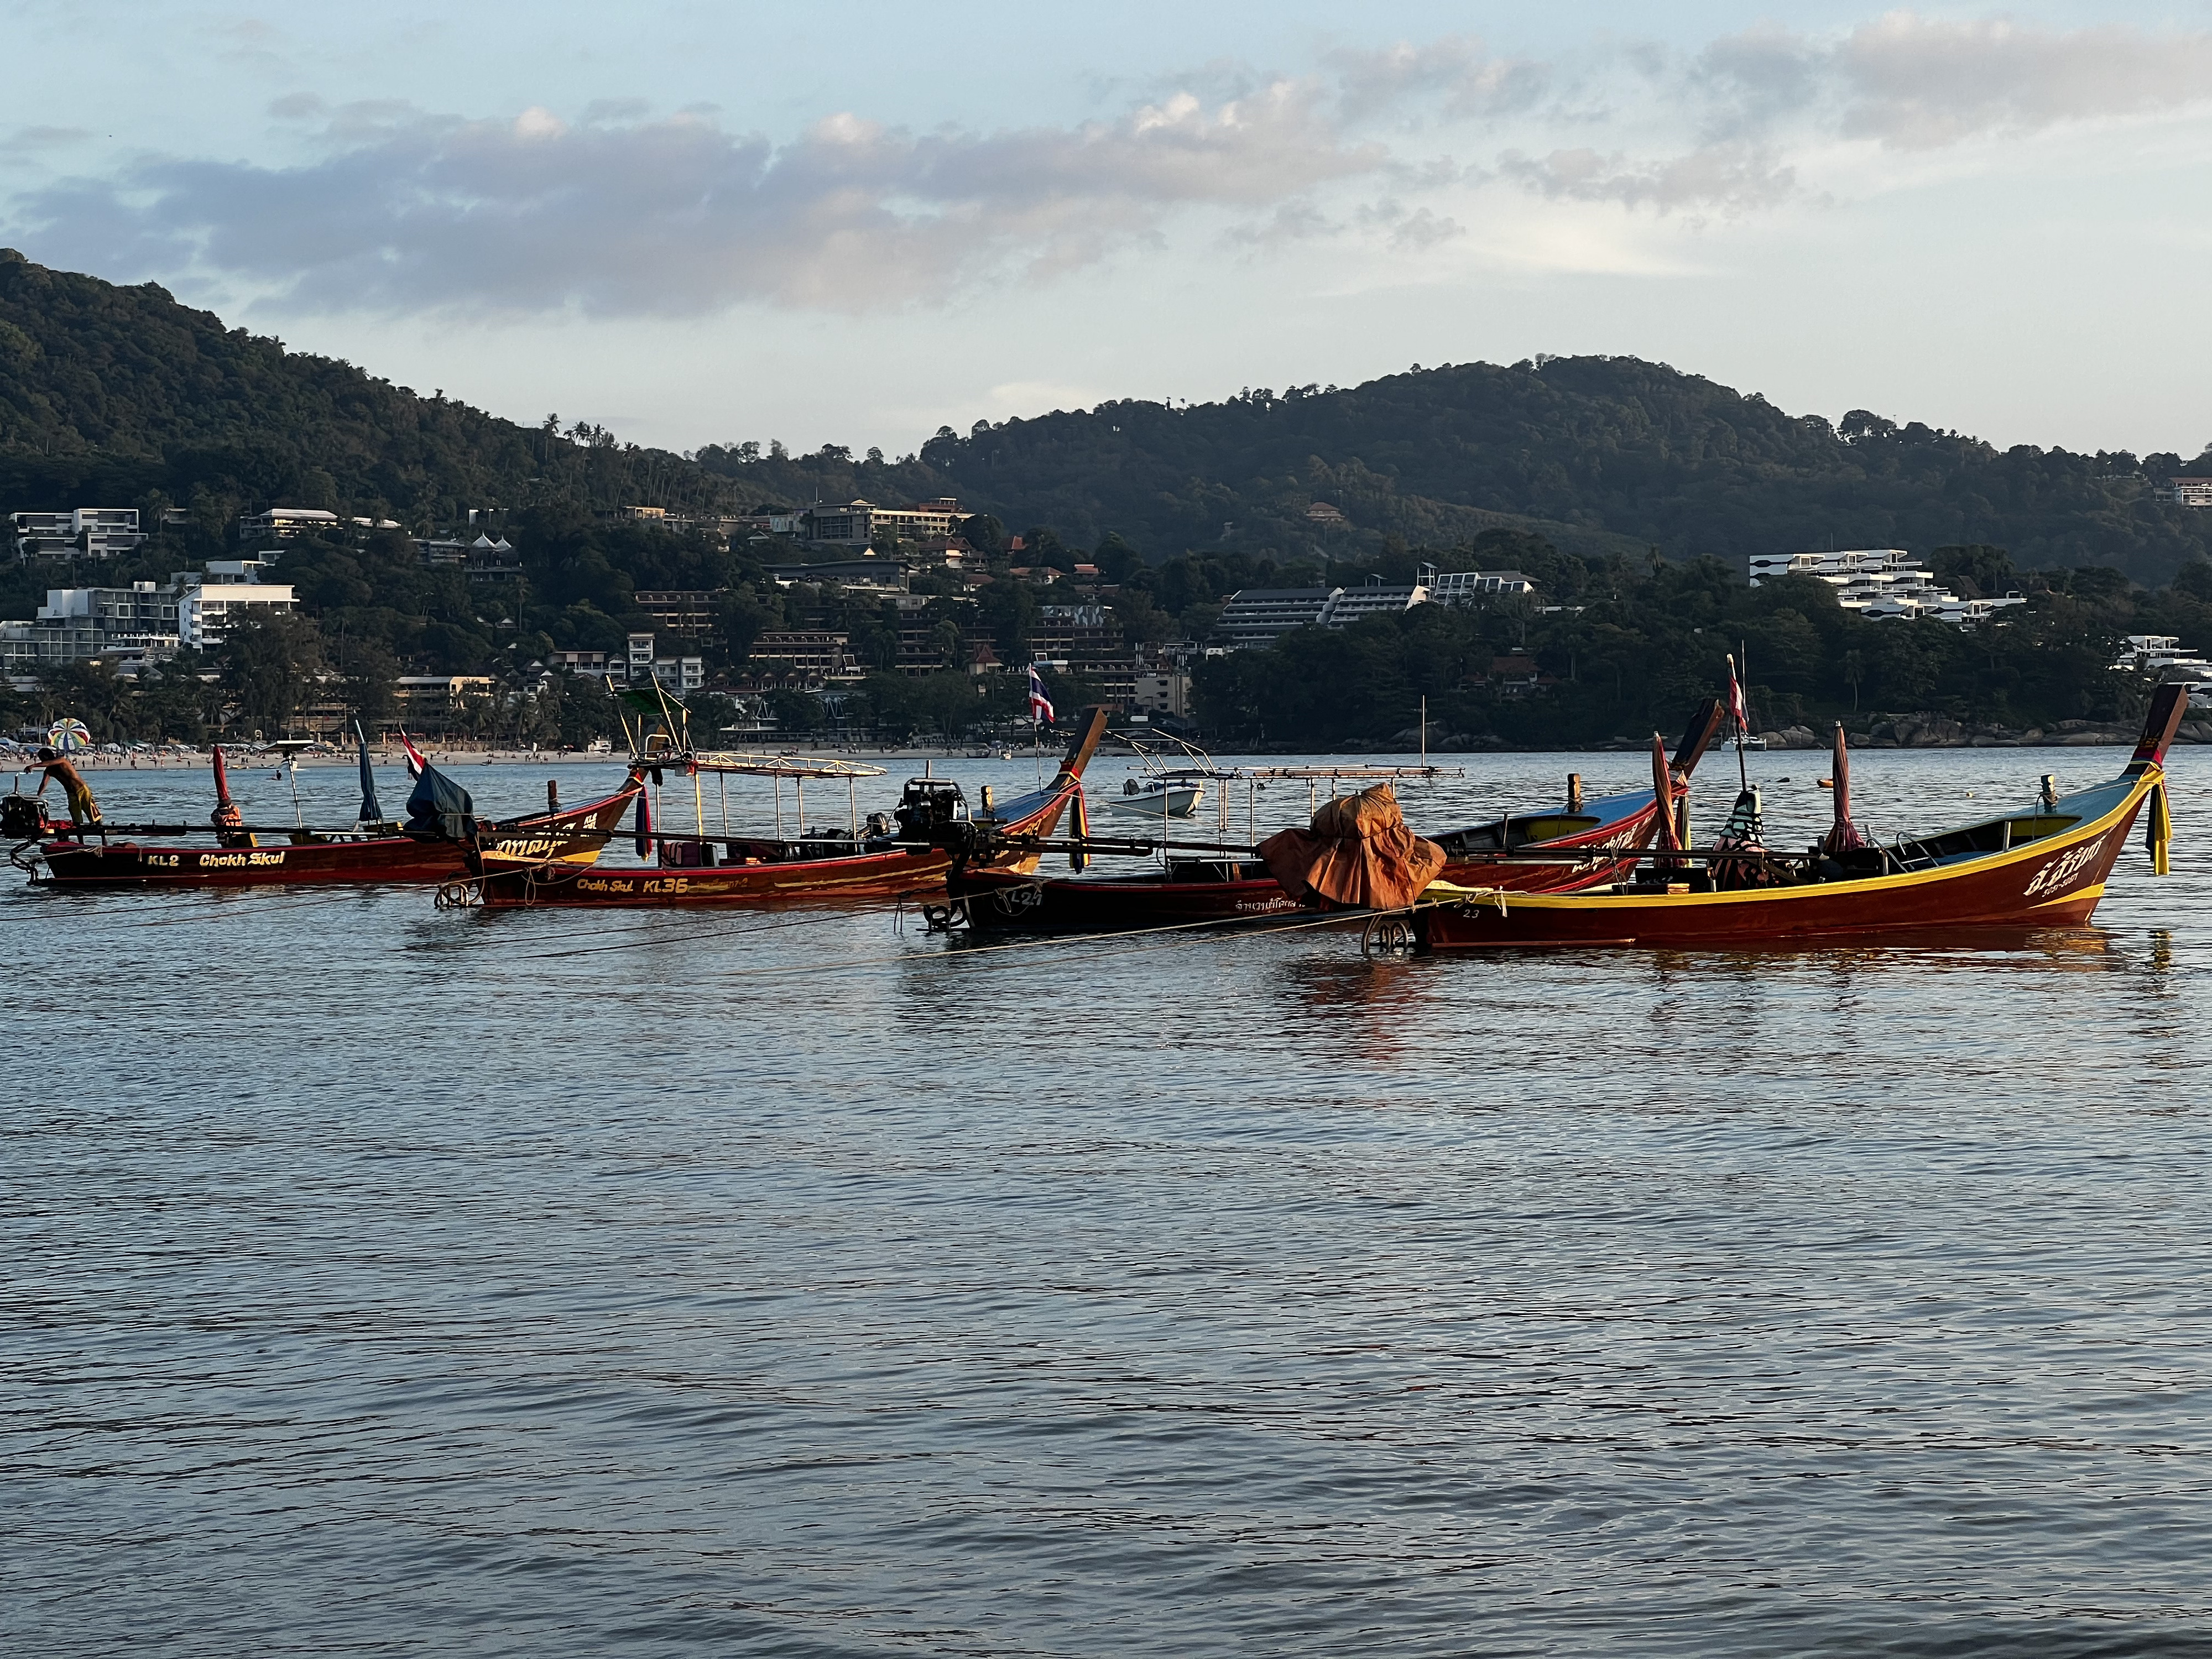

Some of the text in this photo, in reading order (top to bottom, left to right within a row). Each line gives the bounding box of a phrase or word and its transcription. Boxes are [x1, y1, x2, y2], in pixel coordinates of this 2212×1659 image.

[200, 852, 285, 867] Chokh Skul
[643, 878, 688, 893] KL36
[1463, 909, 1480, 918] 23
